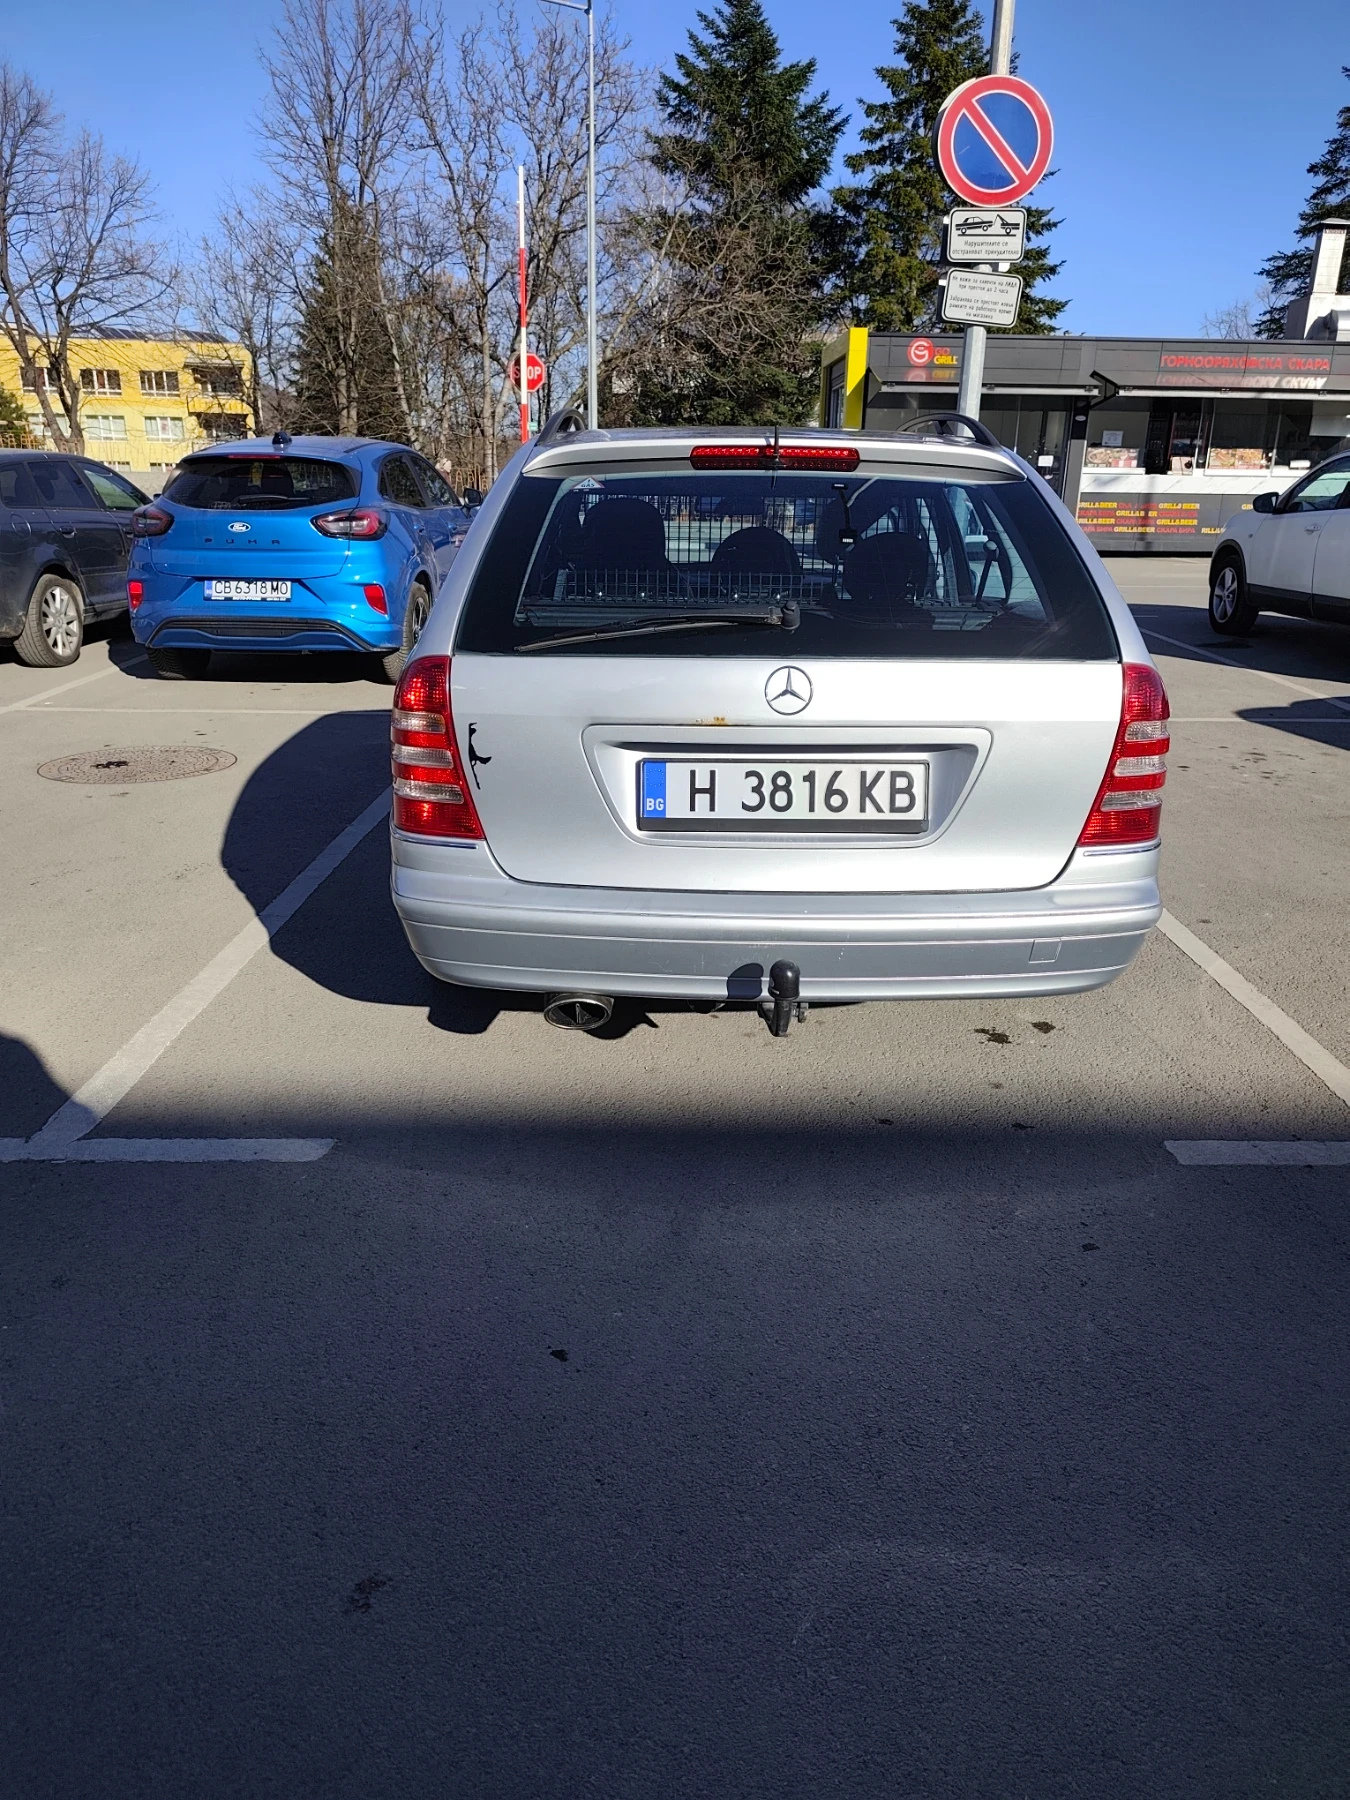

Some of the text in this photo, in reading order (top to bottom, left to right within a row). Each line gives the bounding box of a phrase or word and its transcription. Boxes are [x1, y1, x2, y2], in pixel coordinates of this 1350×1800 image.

[934, 347, 951, 355] GO
[933, 355, 959, 365] GRILL
[1161, 355, 1330, 371] ГОРНООРЯХОВСКА СКАРА
[513, 365, 542, 380] SOP
[234, 581, 267, 595] 6318
[646, 798, 664, 811] BG
[689, 769, 716, 812] H
